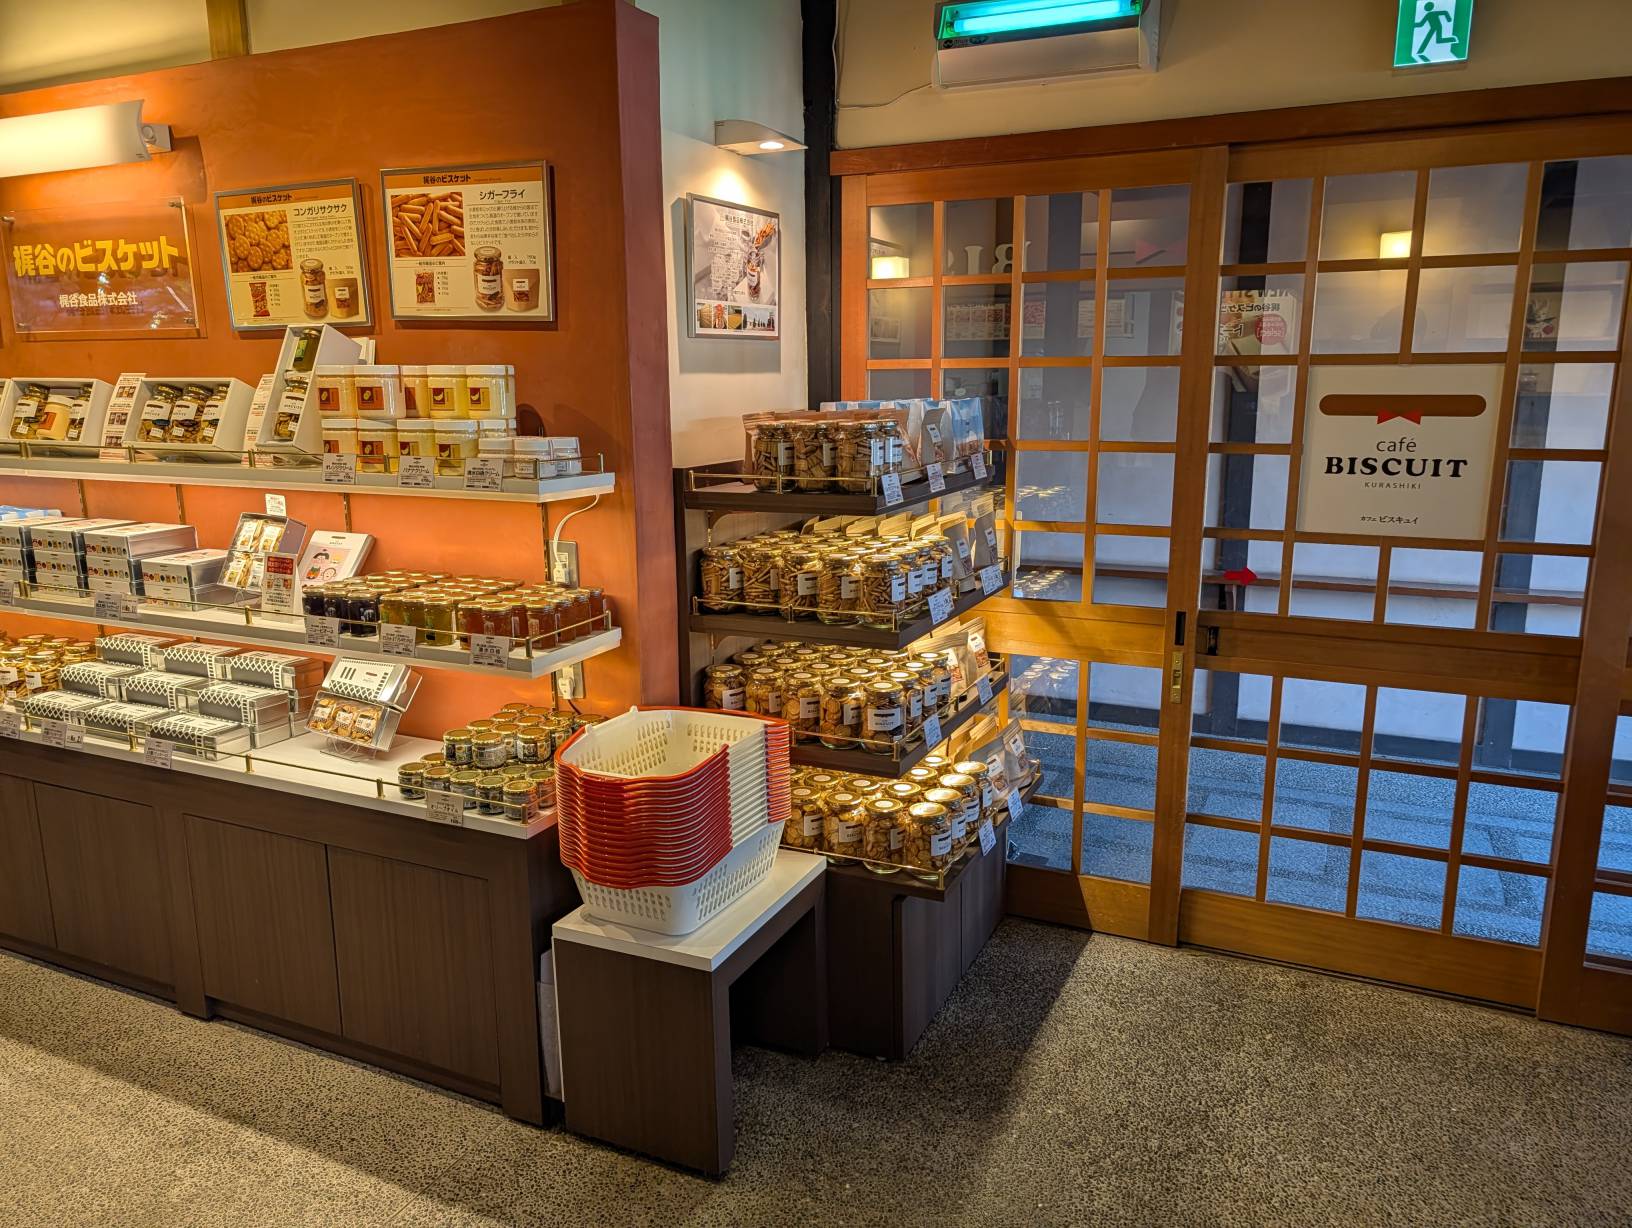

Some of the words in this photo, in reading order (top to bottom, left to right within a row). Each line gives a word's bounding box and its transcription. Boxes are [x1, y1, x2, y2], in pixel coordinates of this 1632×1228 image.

[423, 174, 471, 184] 梶谷のビスケット
[479, 189, 525, 200] シガーフライ
[293, 204, 347, 217] コンガリサクサク
[13, 236, 179, 277] 梶谷のビスケット
[59, 291, 138, 308] 梶谷食品株式会社
[1376, 436, 1418, 452] café
[1324, 457, 1468, 477] BISCUIT
[1379, 515, 1419, 524] ビスキュイ
